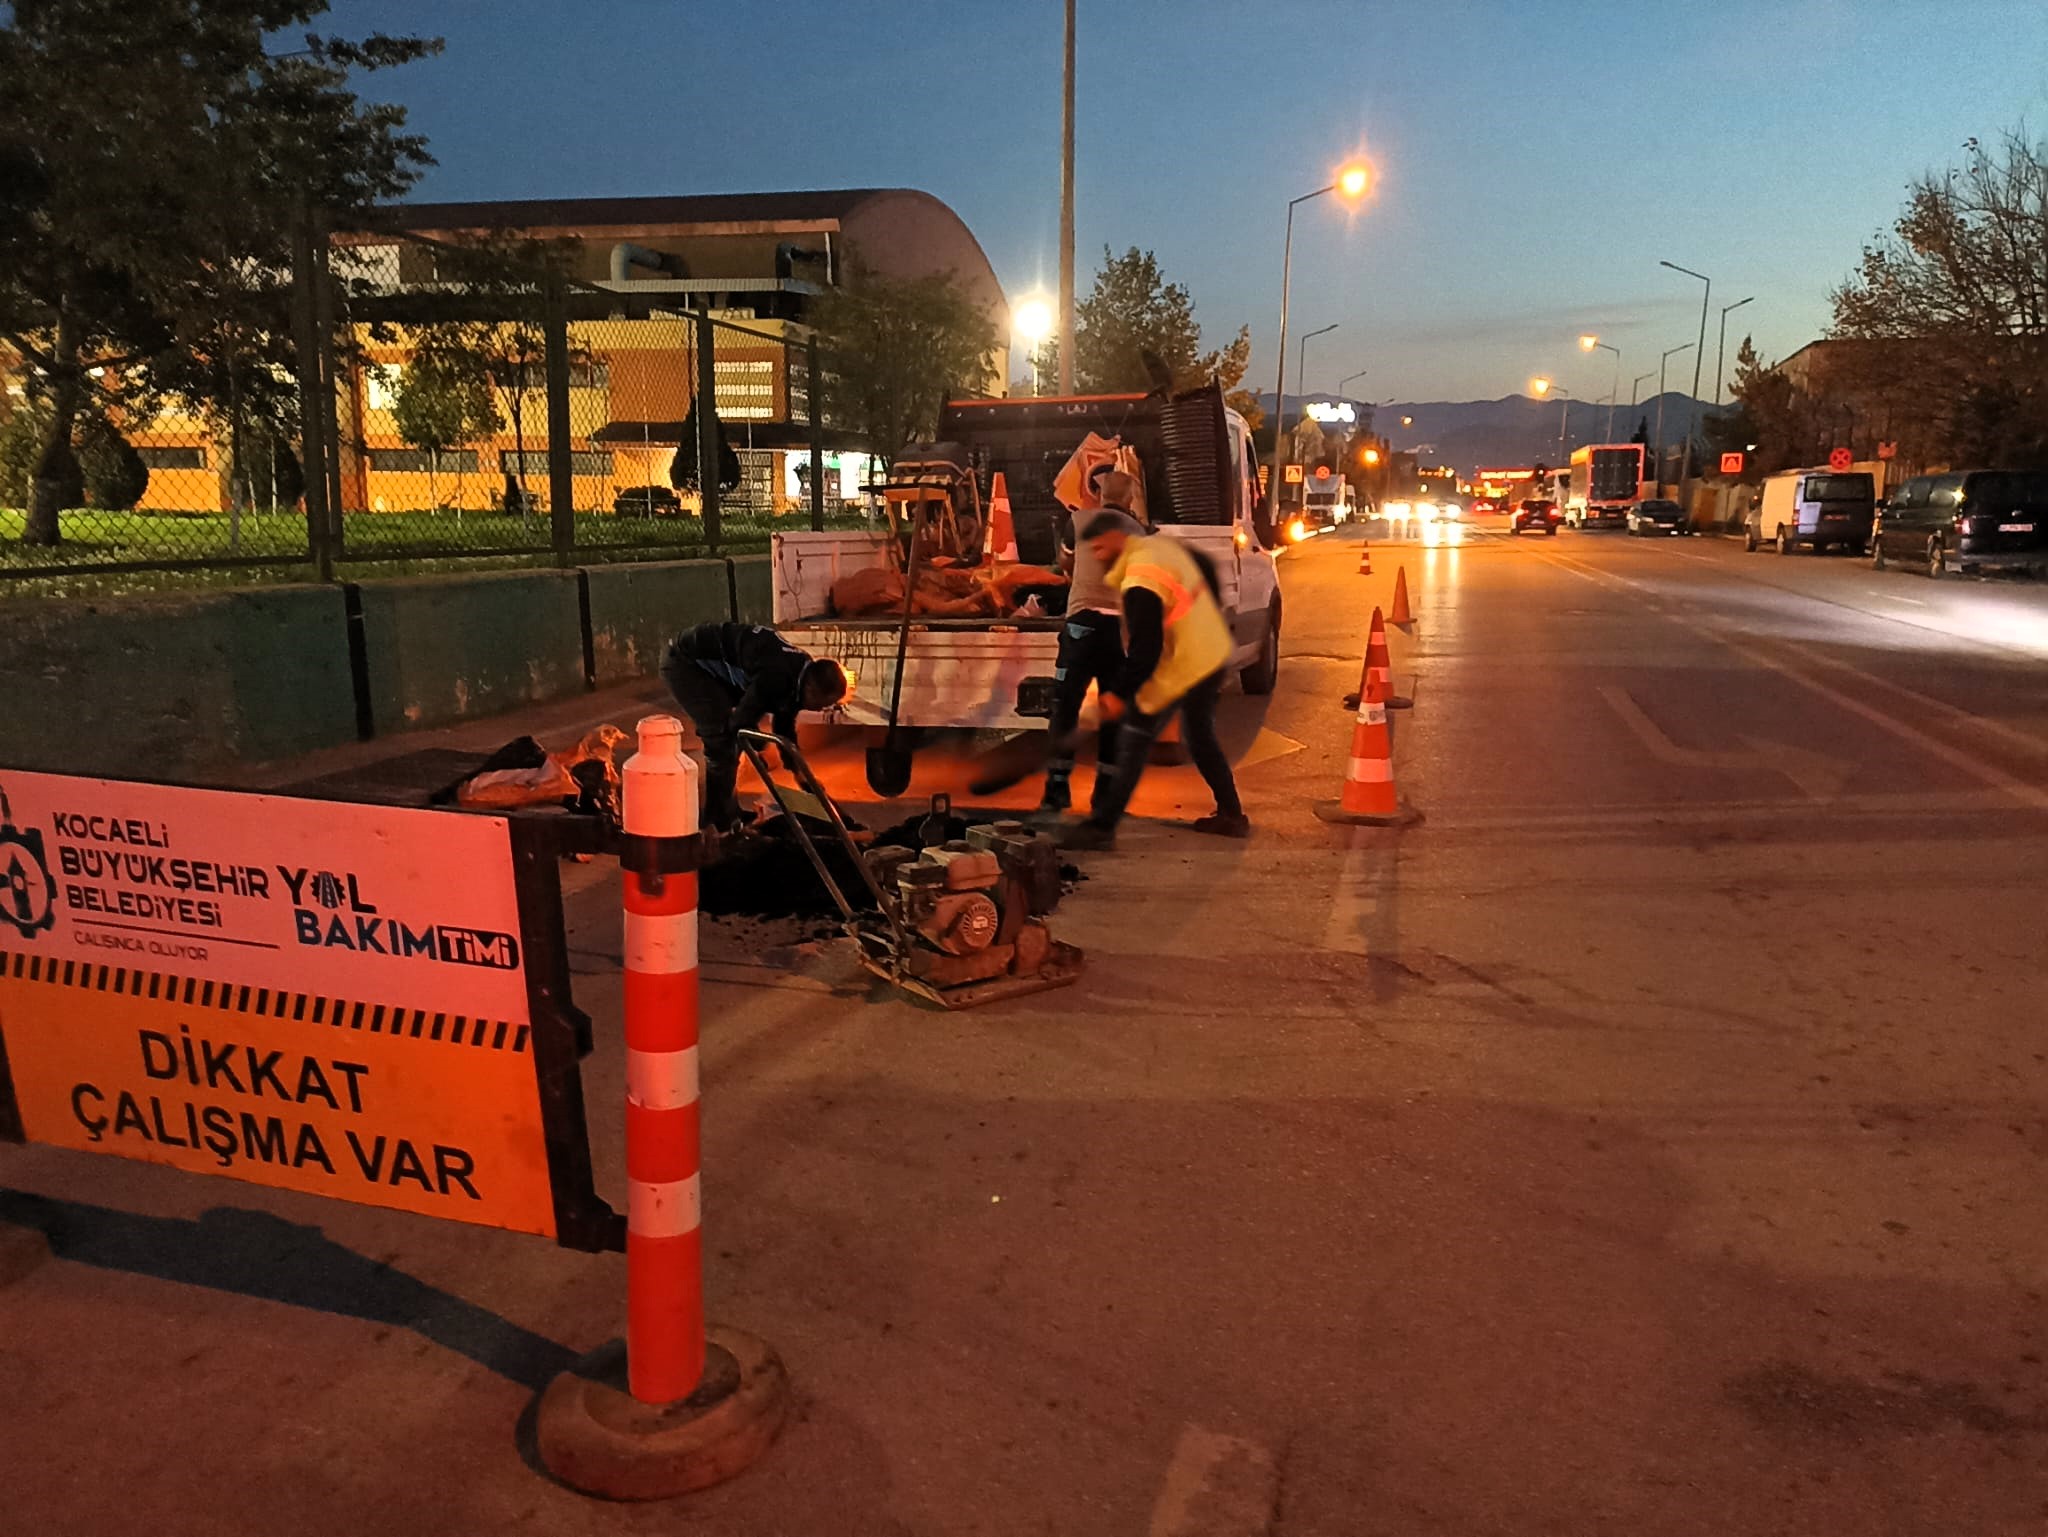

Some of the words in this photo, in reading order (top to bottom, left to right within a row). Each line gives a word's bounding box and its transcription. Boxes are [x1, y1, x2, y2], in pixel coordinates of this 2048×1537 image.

[52, 812, 169, 848] KOCAELİ
[58, 846, 270, 899] BÜYÜKŞEHİR
[65, 884, 222, 927] BELEDİYESİ
[149, 940, 209, 961] OLUYOR
[294, 907, 438, 961] BAKIM
[139, 1024, 369, 1114] DİKKAT
[71, 1082, 336, 1174] ÇALIŞMA
[345, 1130, 482, 1200] VAR
